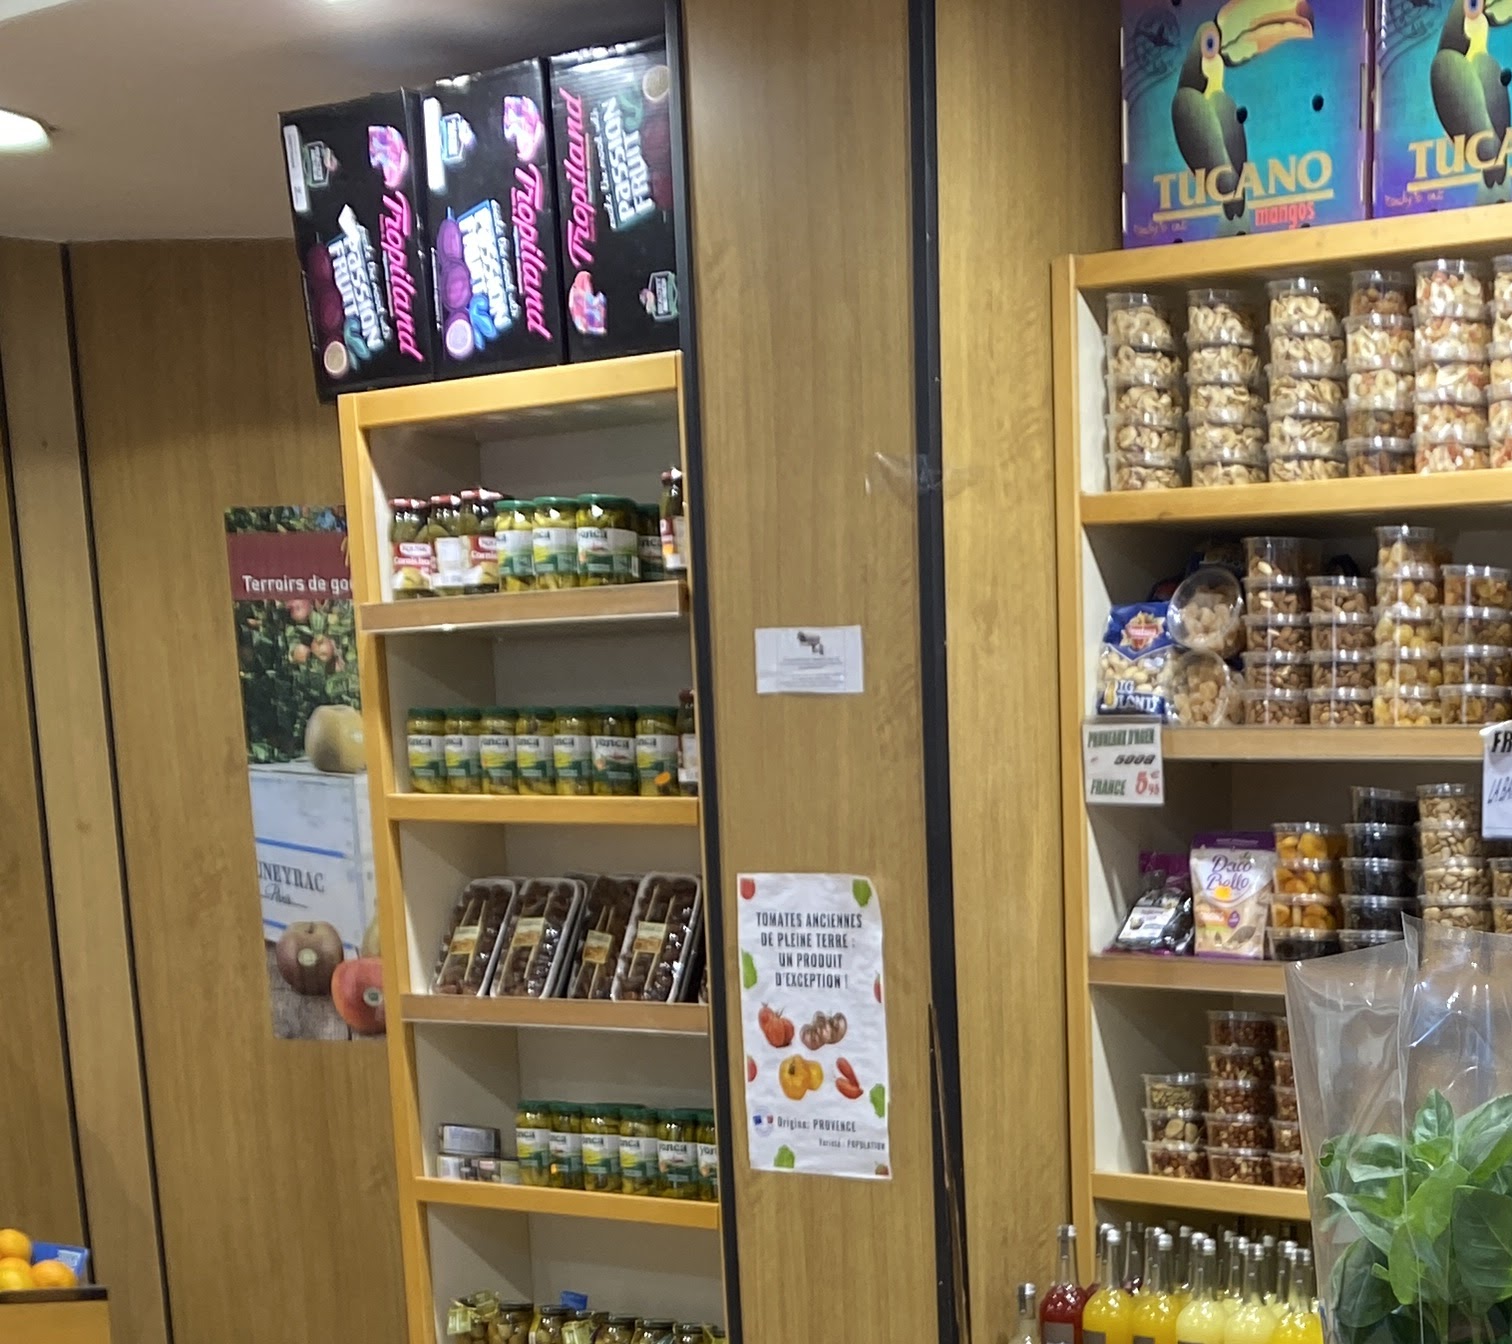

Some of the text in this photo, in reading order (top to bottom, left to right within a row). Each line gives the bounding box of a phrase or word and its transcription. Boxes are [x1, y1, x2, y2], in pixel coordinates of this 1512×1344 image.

[559, 87, 596, 267] Tropiland
[1154, 151, 1332, 209] TUCANO
[1255, 203, 1315, 229] mangos
[510, 163, 553, 341] Tropiland
[379, 190, 425, 362] Tropiland
[242, 575, 305, 592] Terroirs
[308, 574, 326, 591] de
[1090, 779, 1126, 796] FRANCE
[1212, 855, 1251, 873] Daco
[756, 911, 863, 929] TOMATES ANCIENNES
[760, 932, 849, 949] DE PLEINE TERRE
[778, 952, 843, 969] UN PRODUIT
[775, 972, 841, 989] D'EXCEPTION
[812, 1117, 857, 1133] PROVENCE
